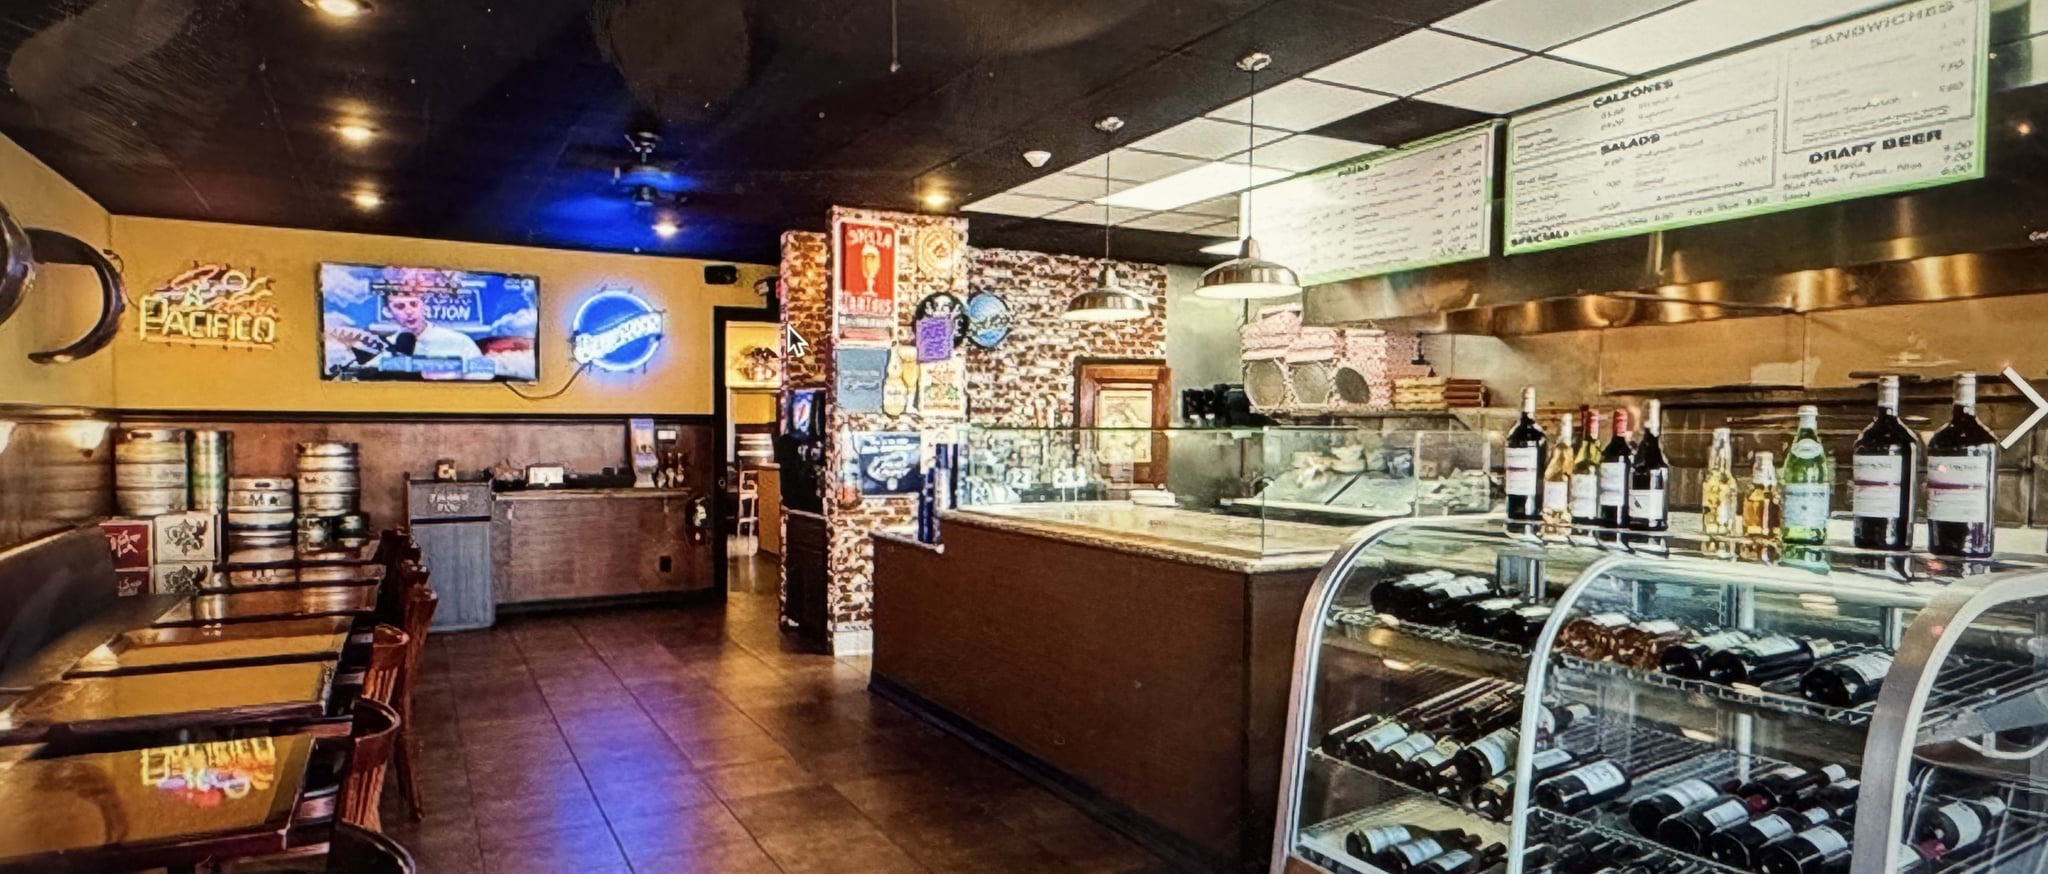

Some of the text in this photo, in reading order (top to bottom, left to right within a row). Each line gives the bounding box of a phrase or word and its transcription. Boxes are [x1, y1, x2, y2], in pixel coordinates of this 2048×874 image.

[1593, 79, 1674, 109] CALZONES
[1601, 133, 1660, 155] SALADS
[1808, 129, 1942, 164] DRAFT BEER
[847, 228, 893, 249] STELLA
[139, 294, 276, 343] PACIFICO
